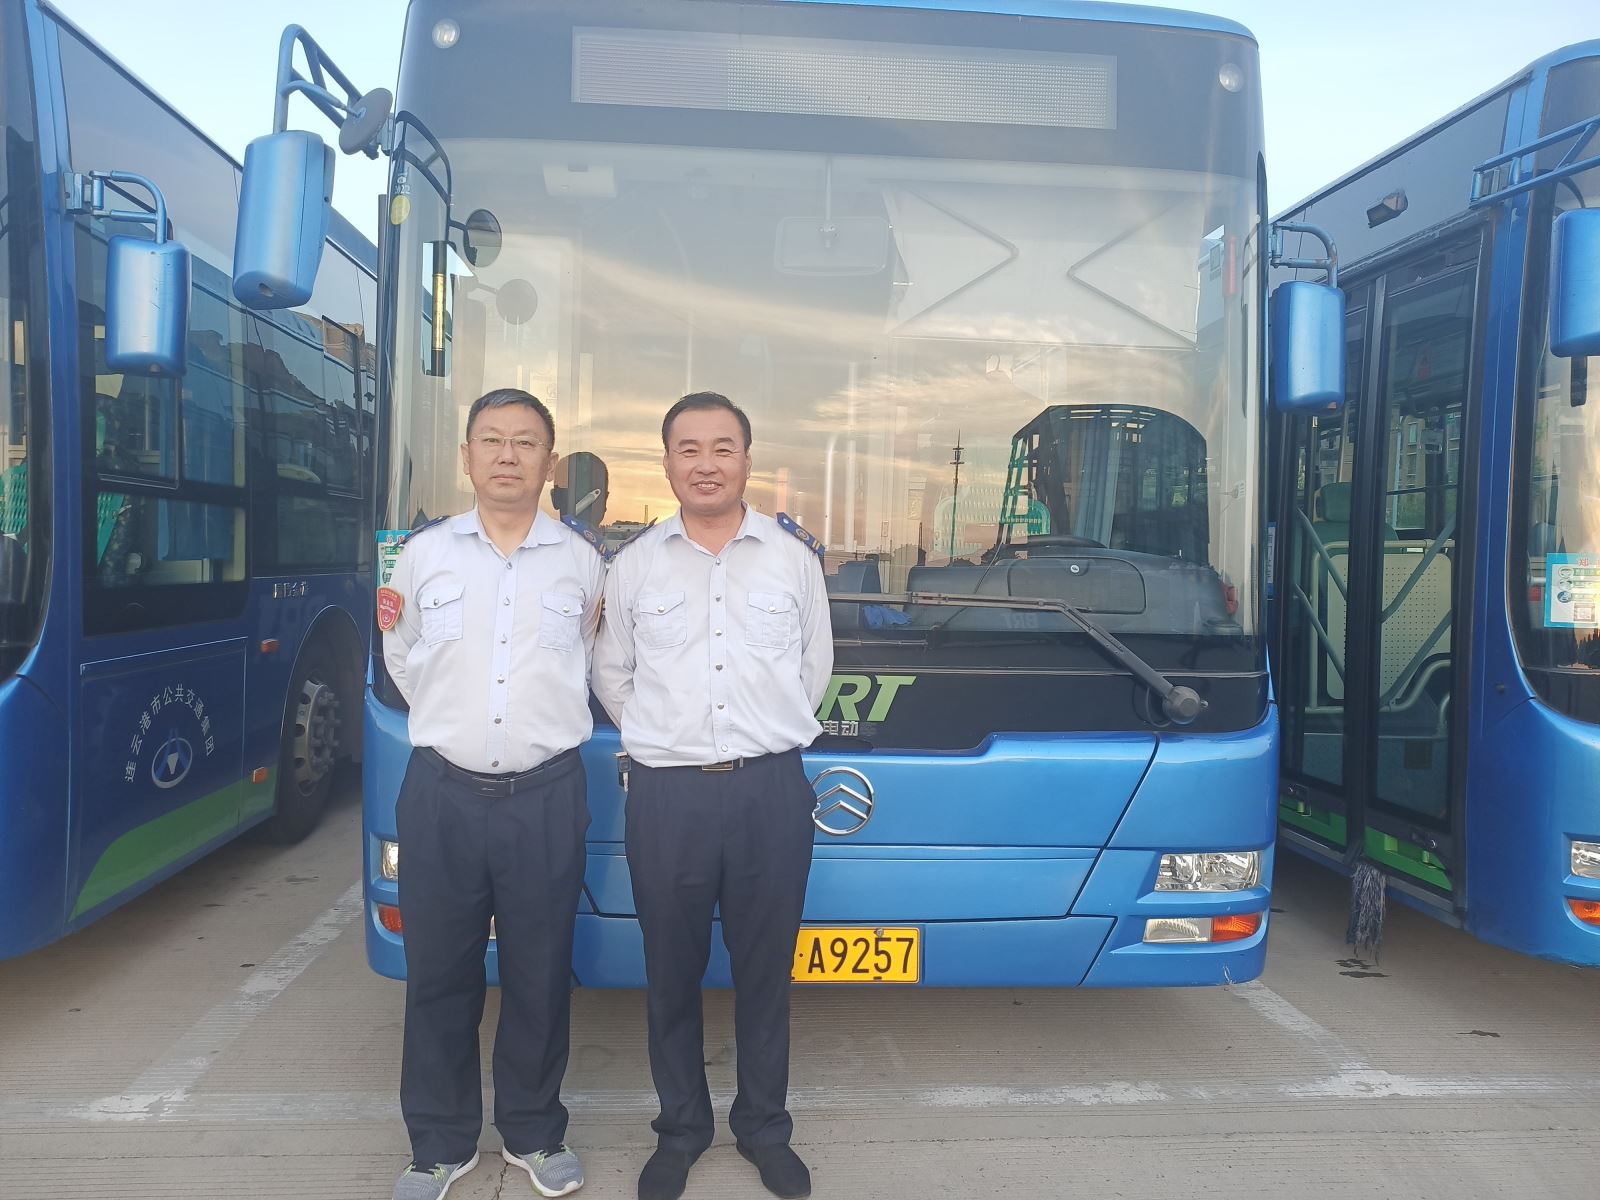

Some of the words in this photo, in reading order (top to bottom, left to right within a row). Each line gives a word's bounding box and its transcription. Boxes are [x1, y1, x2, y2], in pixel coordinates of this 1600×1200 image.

[124, 683, 215, 783] 连云港市公共交通集团
